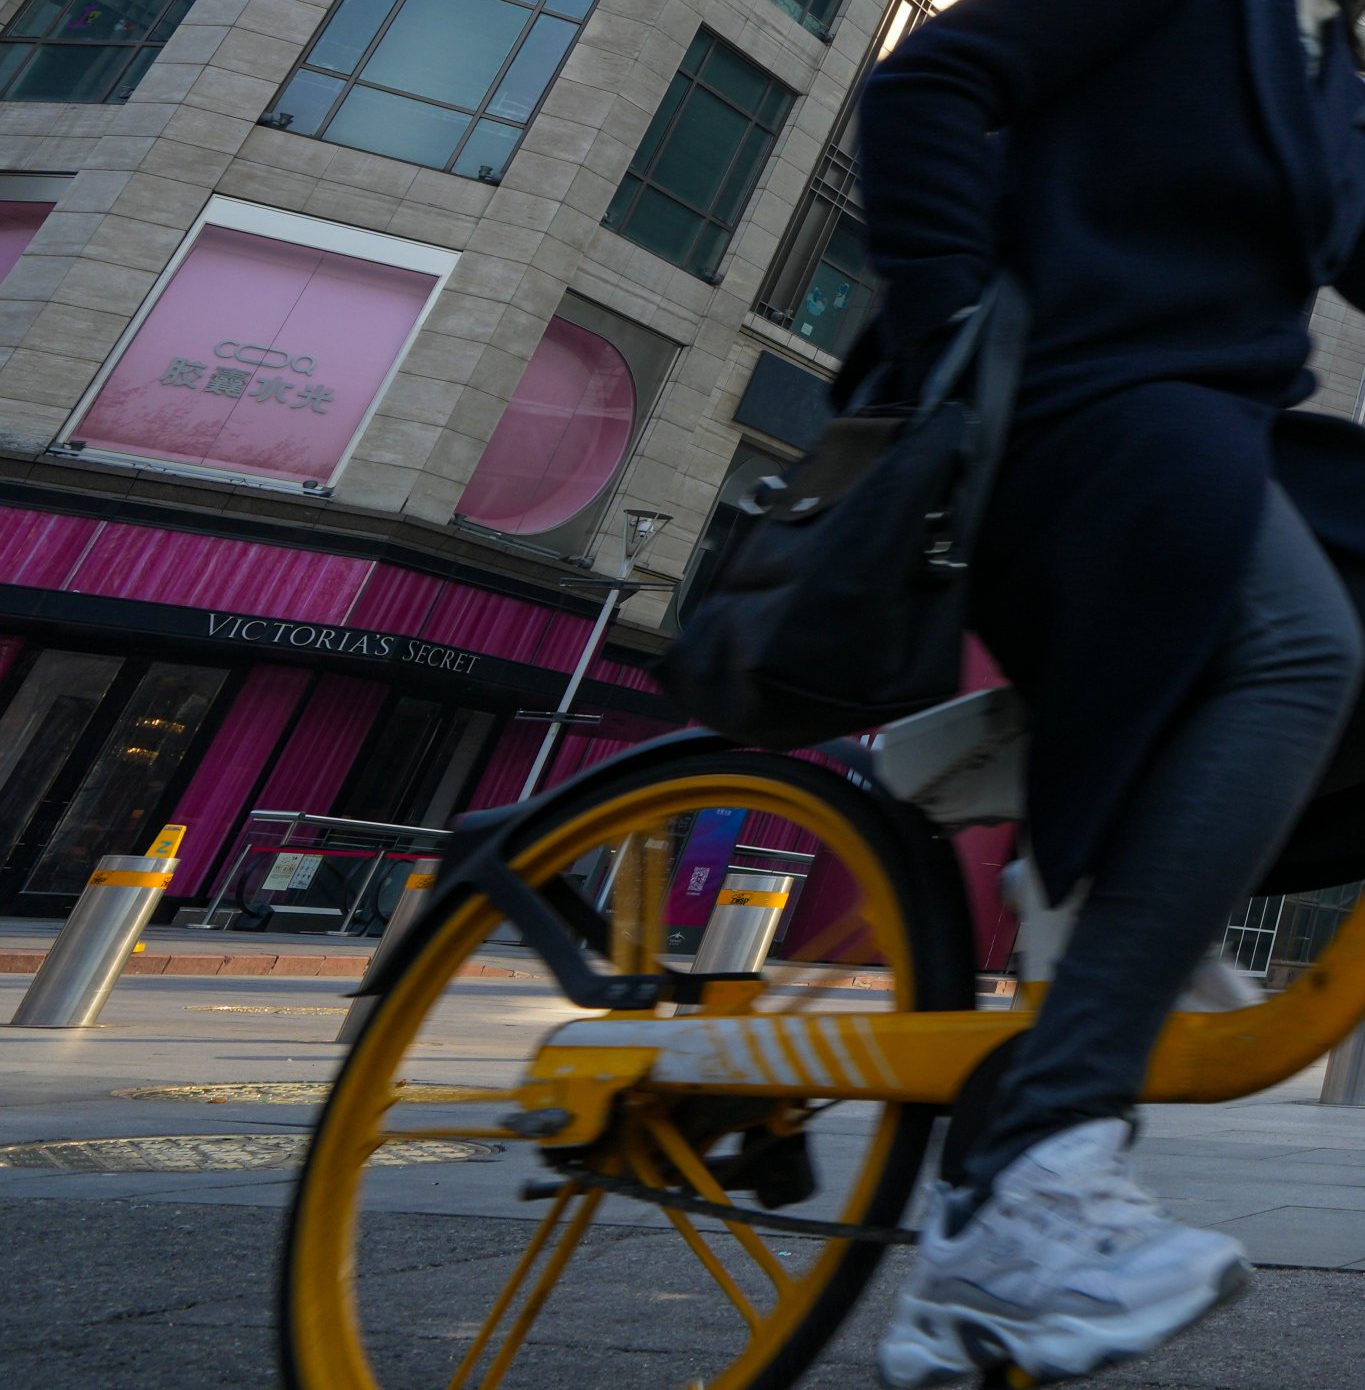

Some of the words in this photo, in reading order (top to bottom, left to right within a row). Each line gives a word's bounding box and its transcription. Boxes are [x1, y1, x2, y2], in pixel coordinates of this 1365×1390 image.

[159, 356, 337, 415] 胶囊水光
[207, 613, 394, 657] VICTORIA'S
[401, 639, 482, 675] SECRET
